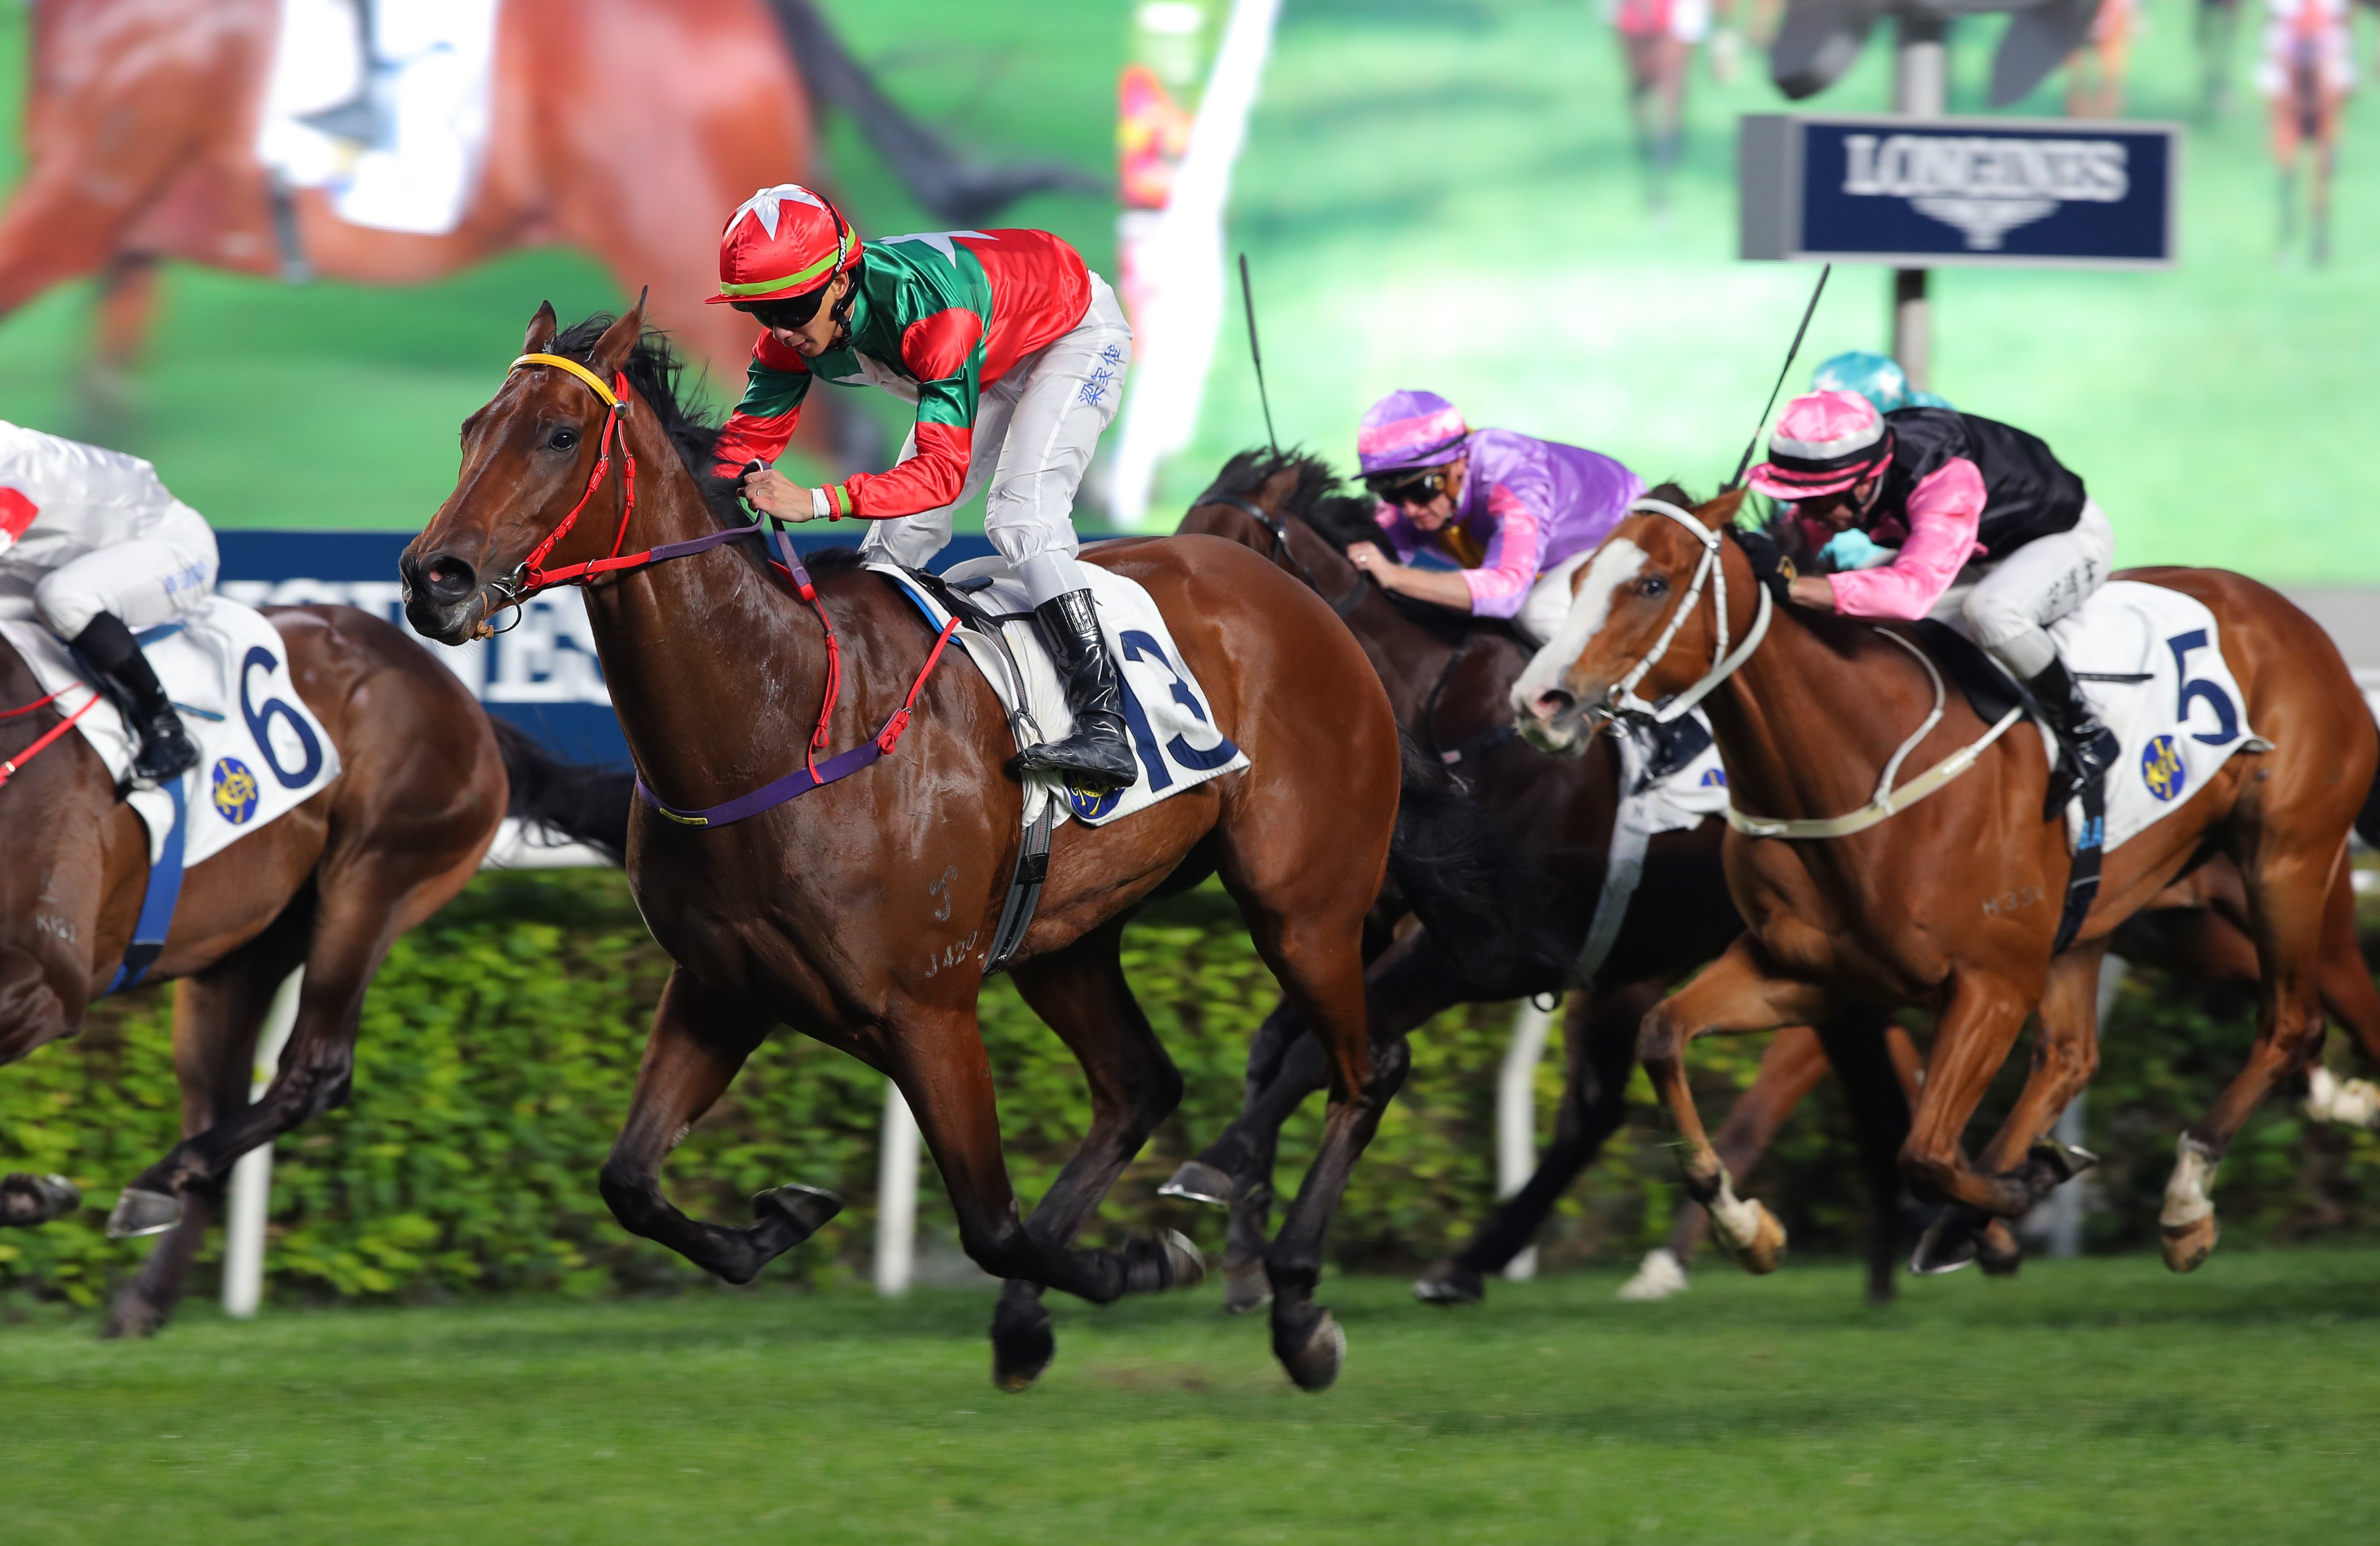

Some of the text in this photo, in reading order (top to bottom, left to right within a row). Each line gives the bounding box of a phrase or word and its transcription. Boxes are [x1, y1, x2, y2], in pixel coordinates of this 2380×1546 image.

[1842, 134, 2128, 203] LONGINES
[835, 235, 846, 273] SHORE
[241, 646, 323, 789] 6
[1109, 629, 1240, 793] 13
[2167, 628, 2241, 746] 5
[925, 928, 978, 978] J420
